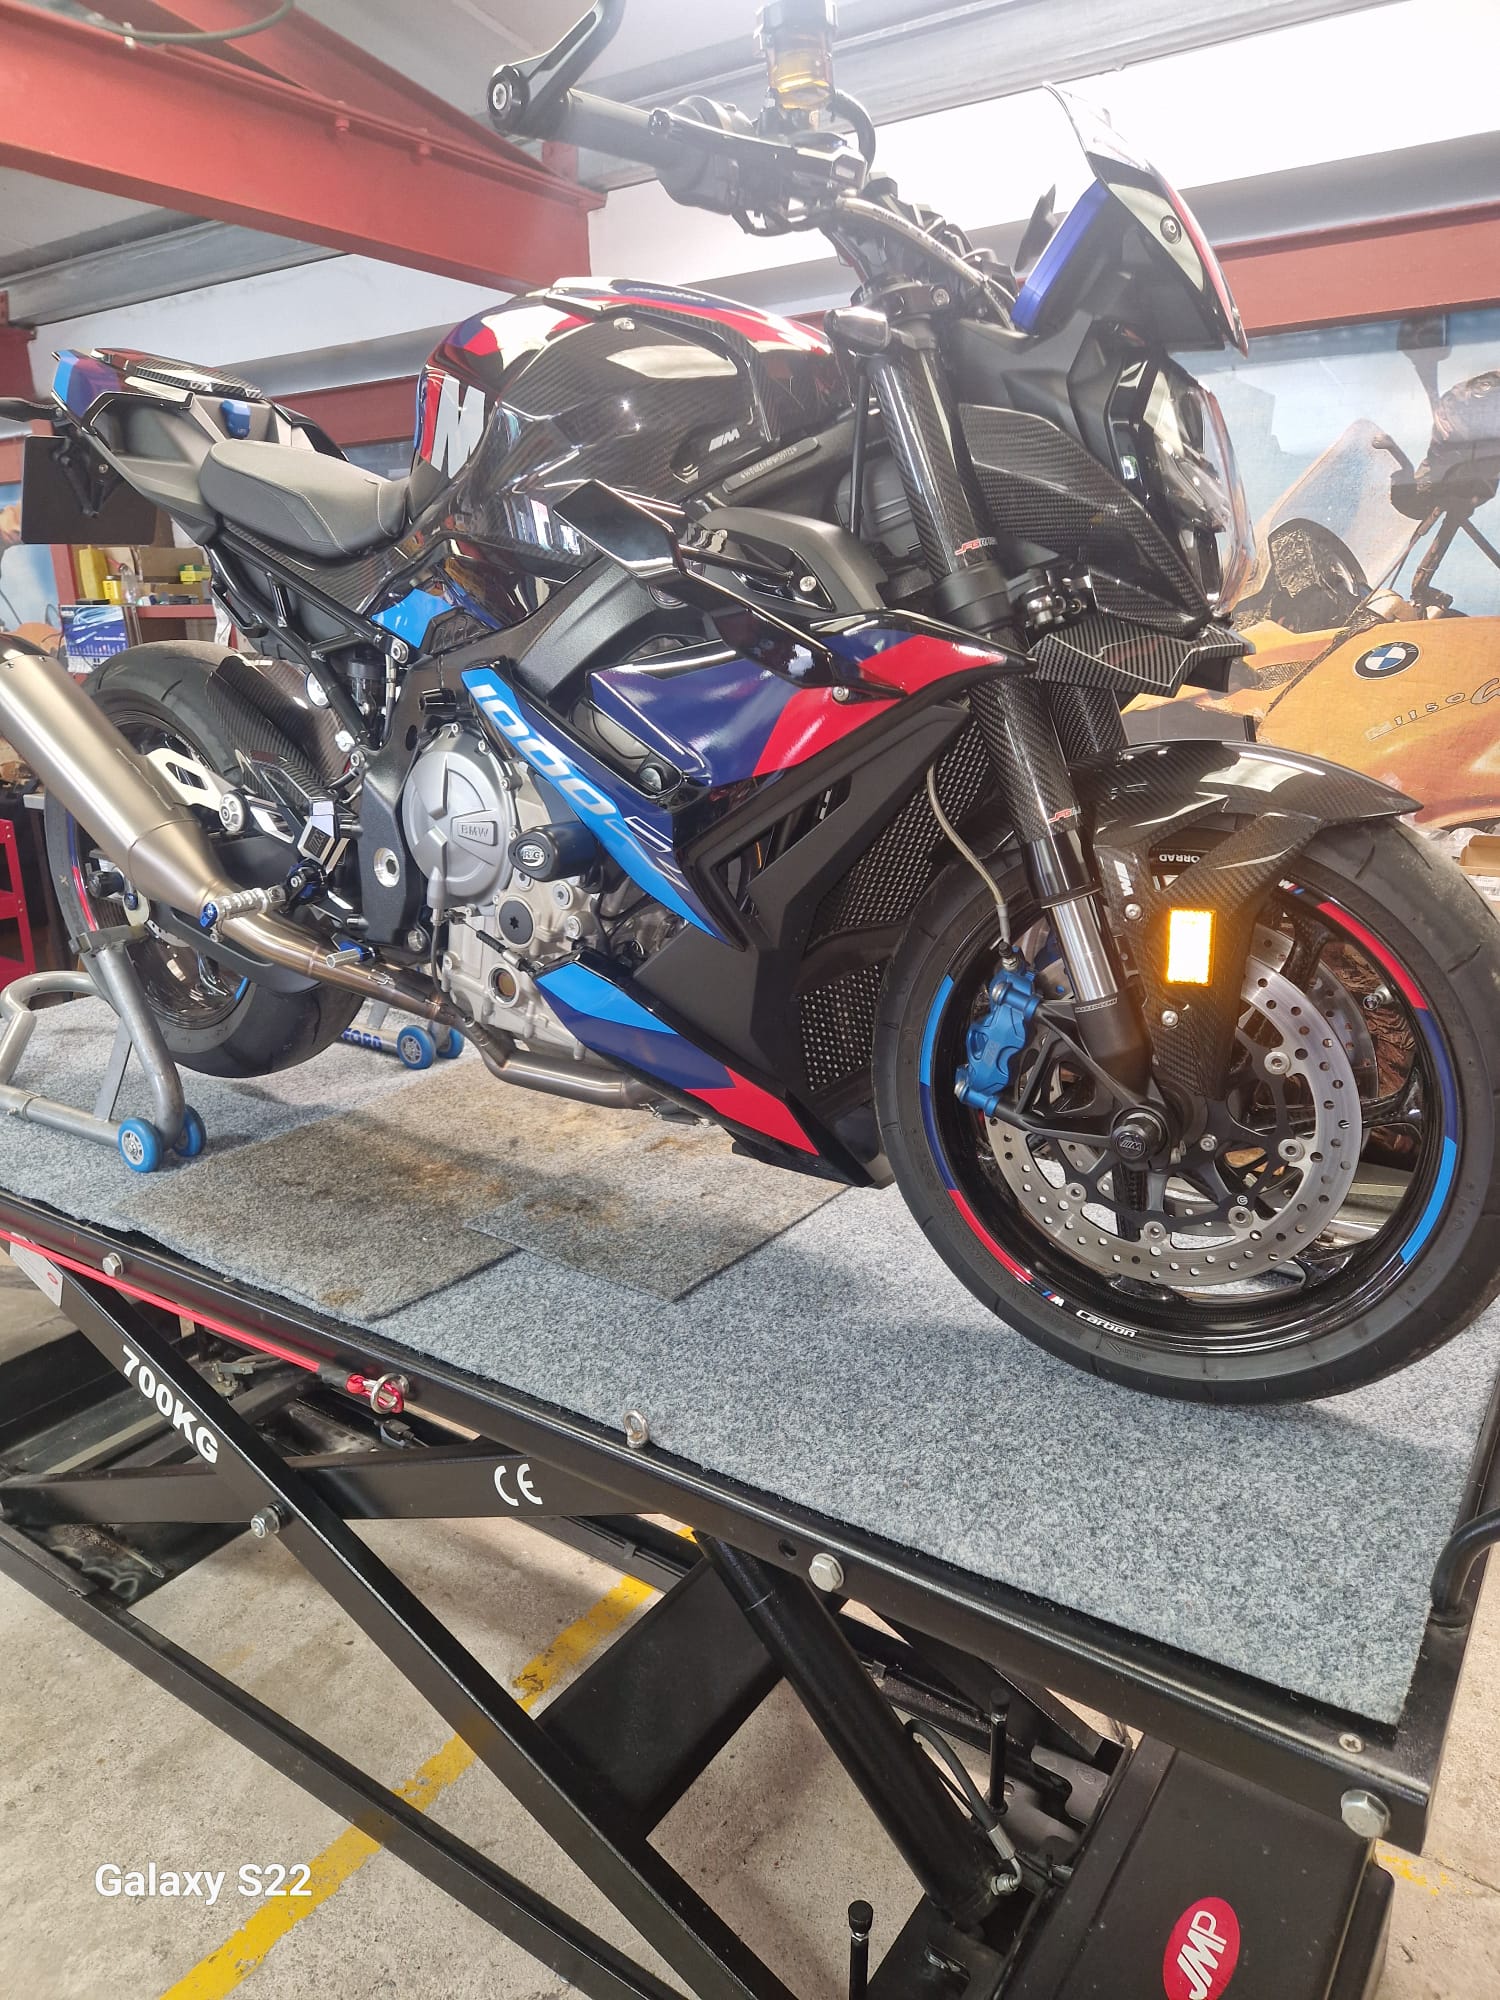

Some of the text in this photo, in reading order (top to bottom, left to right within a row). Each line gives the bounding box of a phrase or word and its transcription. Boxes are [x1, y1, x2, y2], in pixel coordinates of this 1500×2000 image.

[461, 824, 489, 838] BMW
[1158, 854, 1200, 863] ORRAD
[1076, 1309, 1139, 1338] Carbon
[122, 1344, 218, 1464] 700KG
[494, 1463, 543, 1507] CE
[1176, 1910, 1227, 2000] JMP
